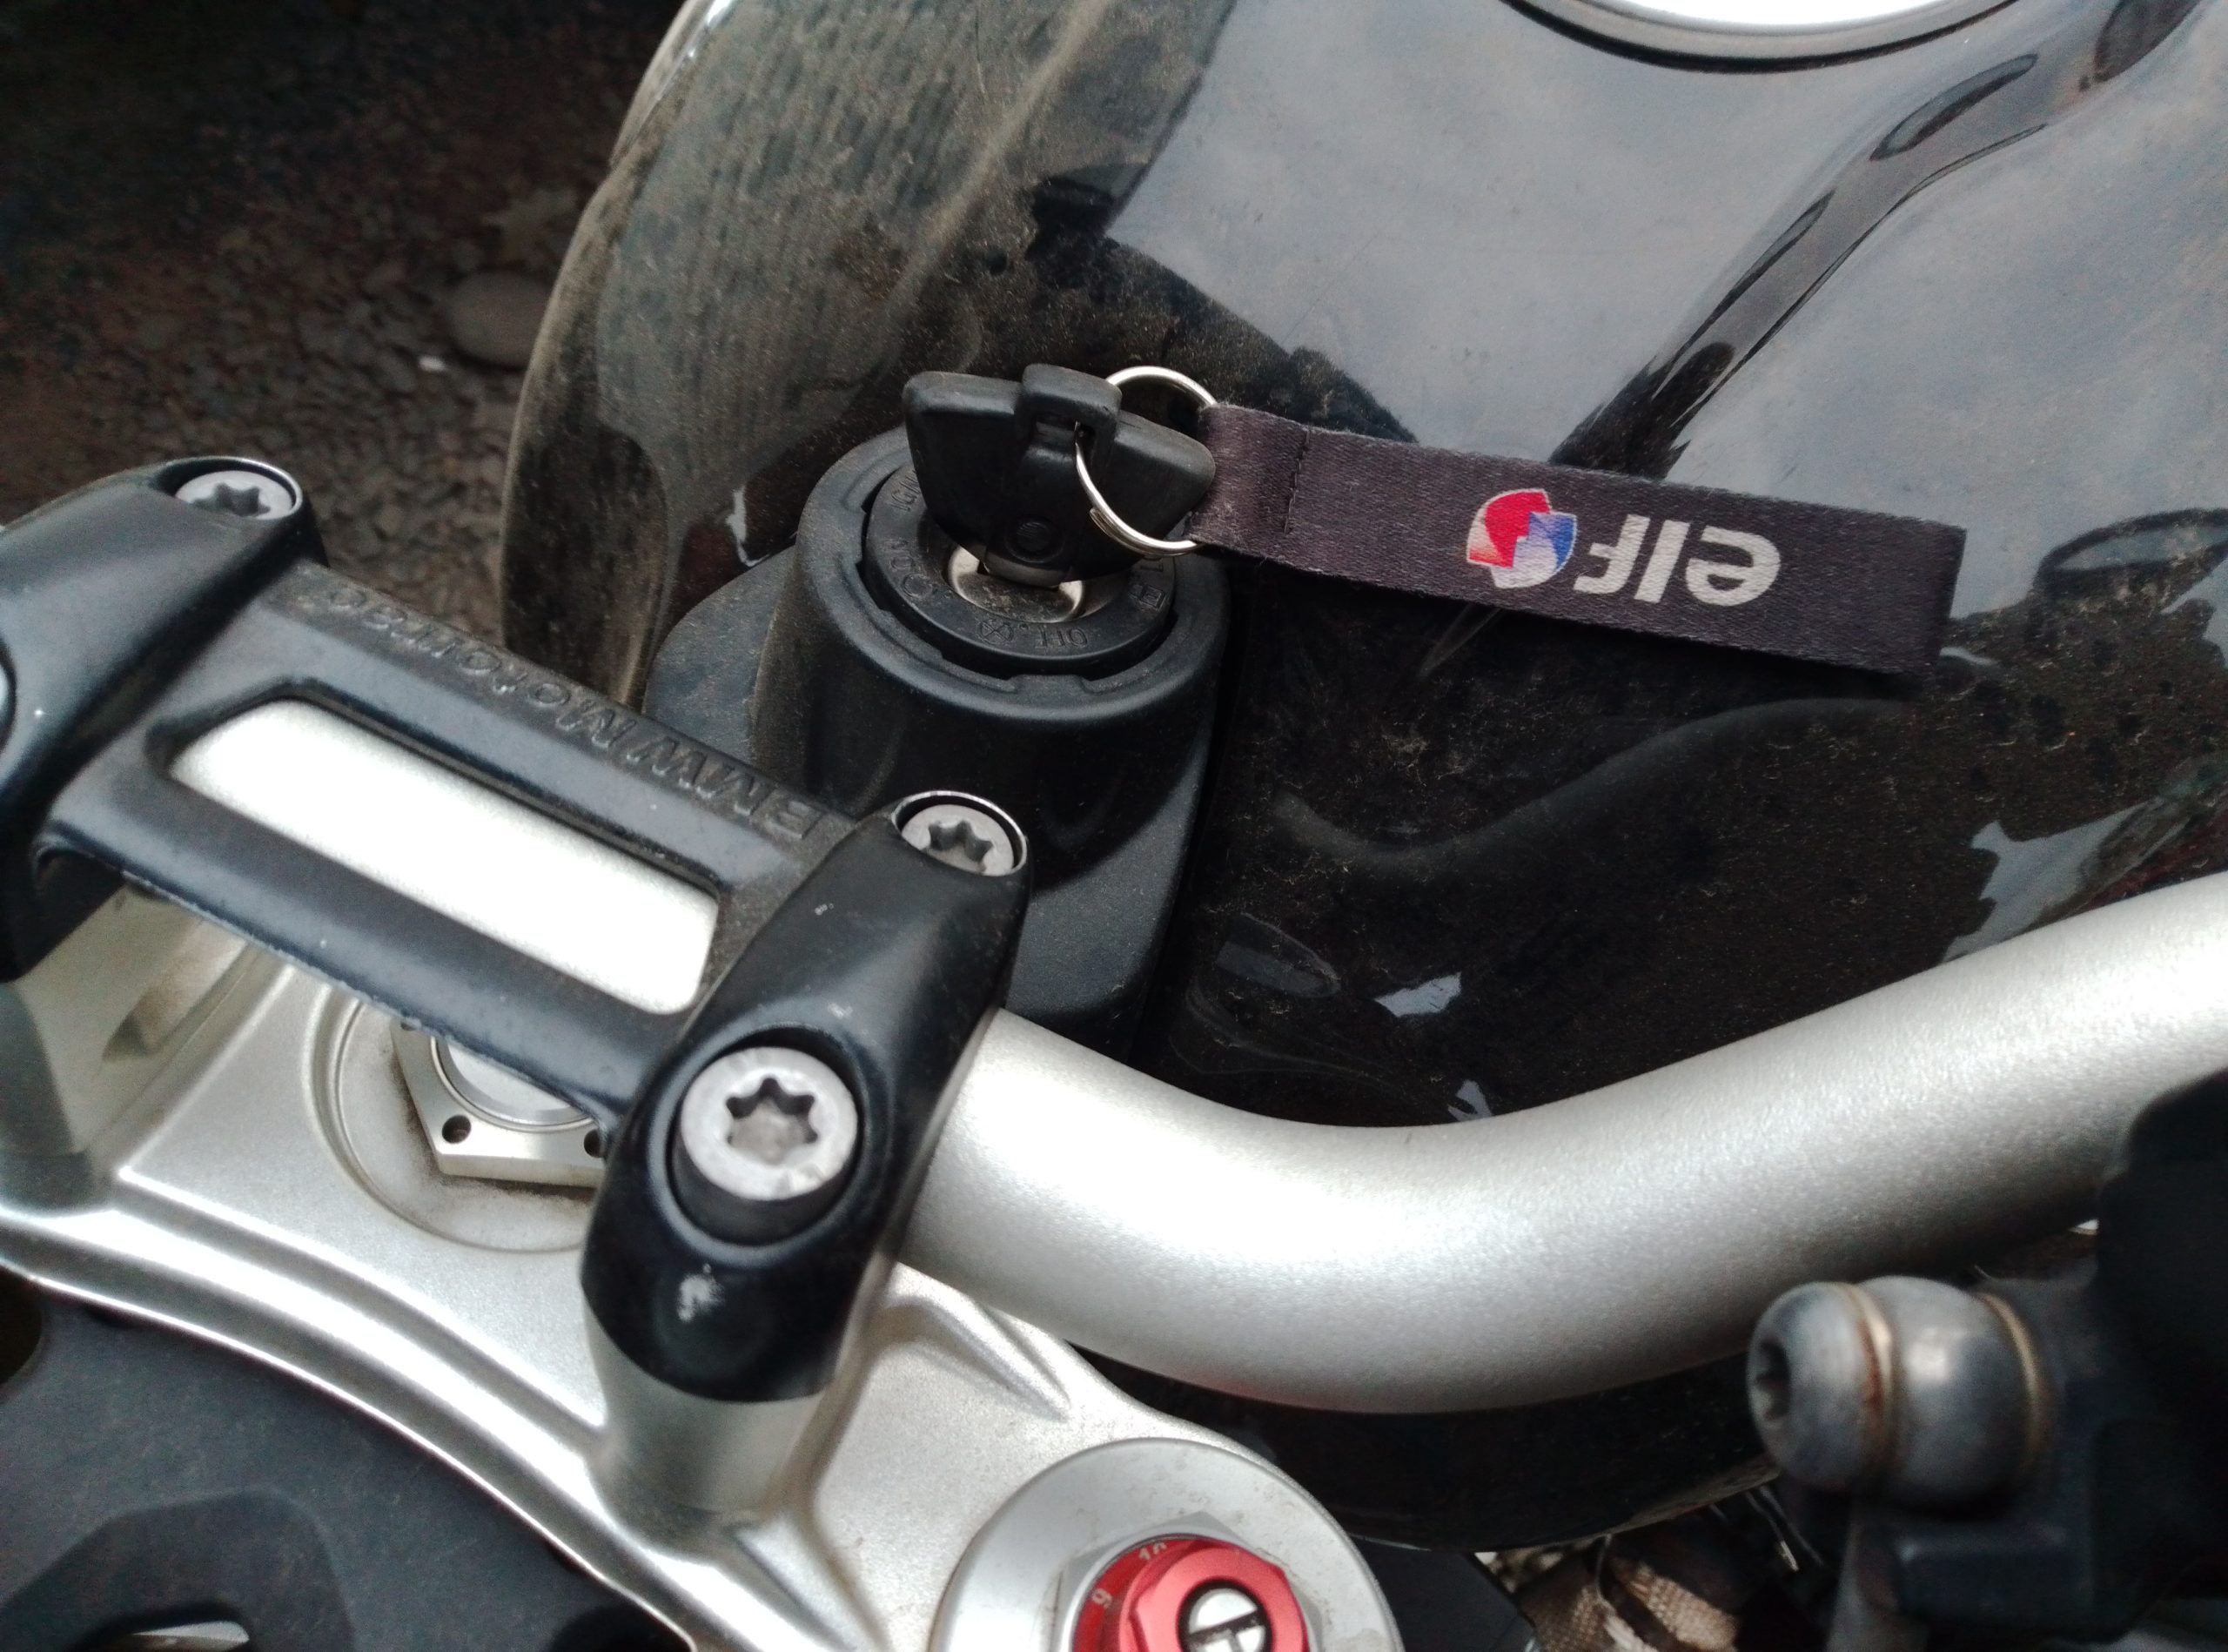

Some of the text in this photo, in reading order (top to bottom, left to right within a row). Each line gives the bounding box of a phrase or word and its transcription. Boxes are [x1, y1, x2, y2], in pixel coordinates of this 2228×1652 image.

[1573, 513, 1782, 607] elf
[1034, 625, 1089, 650] OFF
[625, 734, 826, 842] BMW
